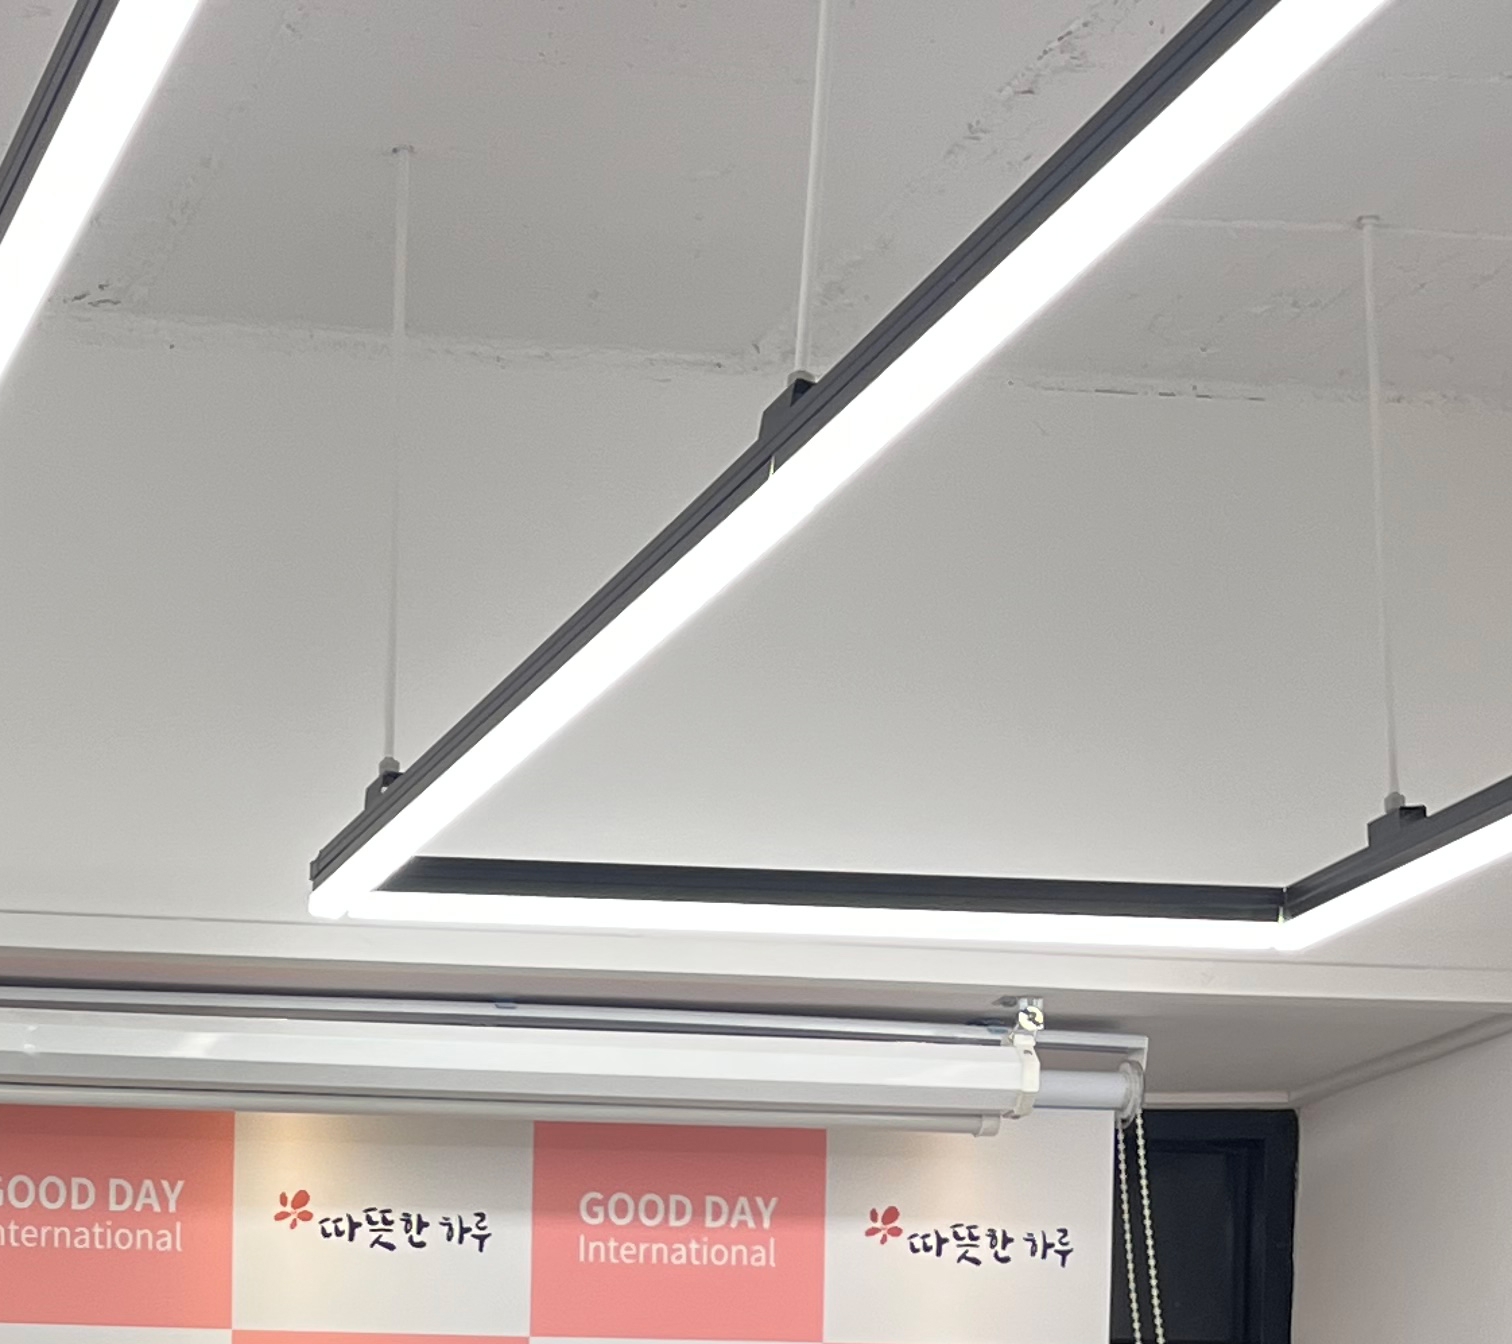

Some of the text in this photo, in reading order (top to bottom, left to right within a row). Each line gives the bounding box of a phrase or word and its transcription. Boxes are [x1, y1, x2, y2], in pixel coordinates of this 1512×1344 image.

[108, 1178, 184, 1212] DAY
[579, 1191, 779, 1229] GOOD DAY
[319, 1206, 491, 1251] 따뜻한 하루
[907, 1223, 1074, 1267] 따뜻한 하루
[579, 1235, 775, 1268] International
